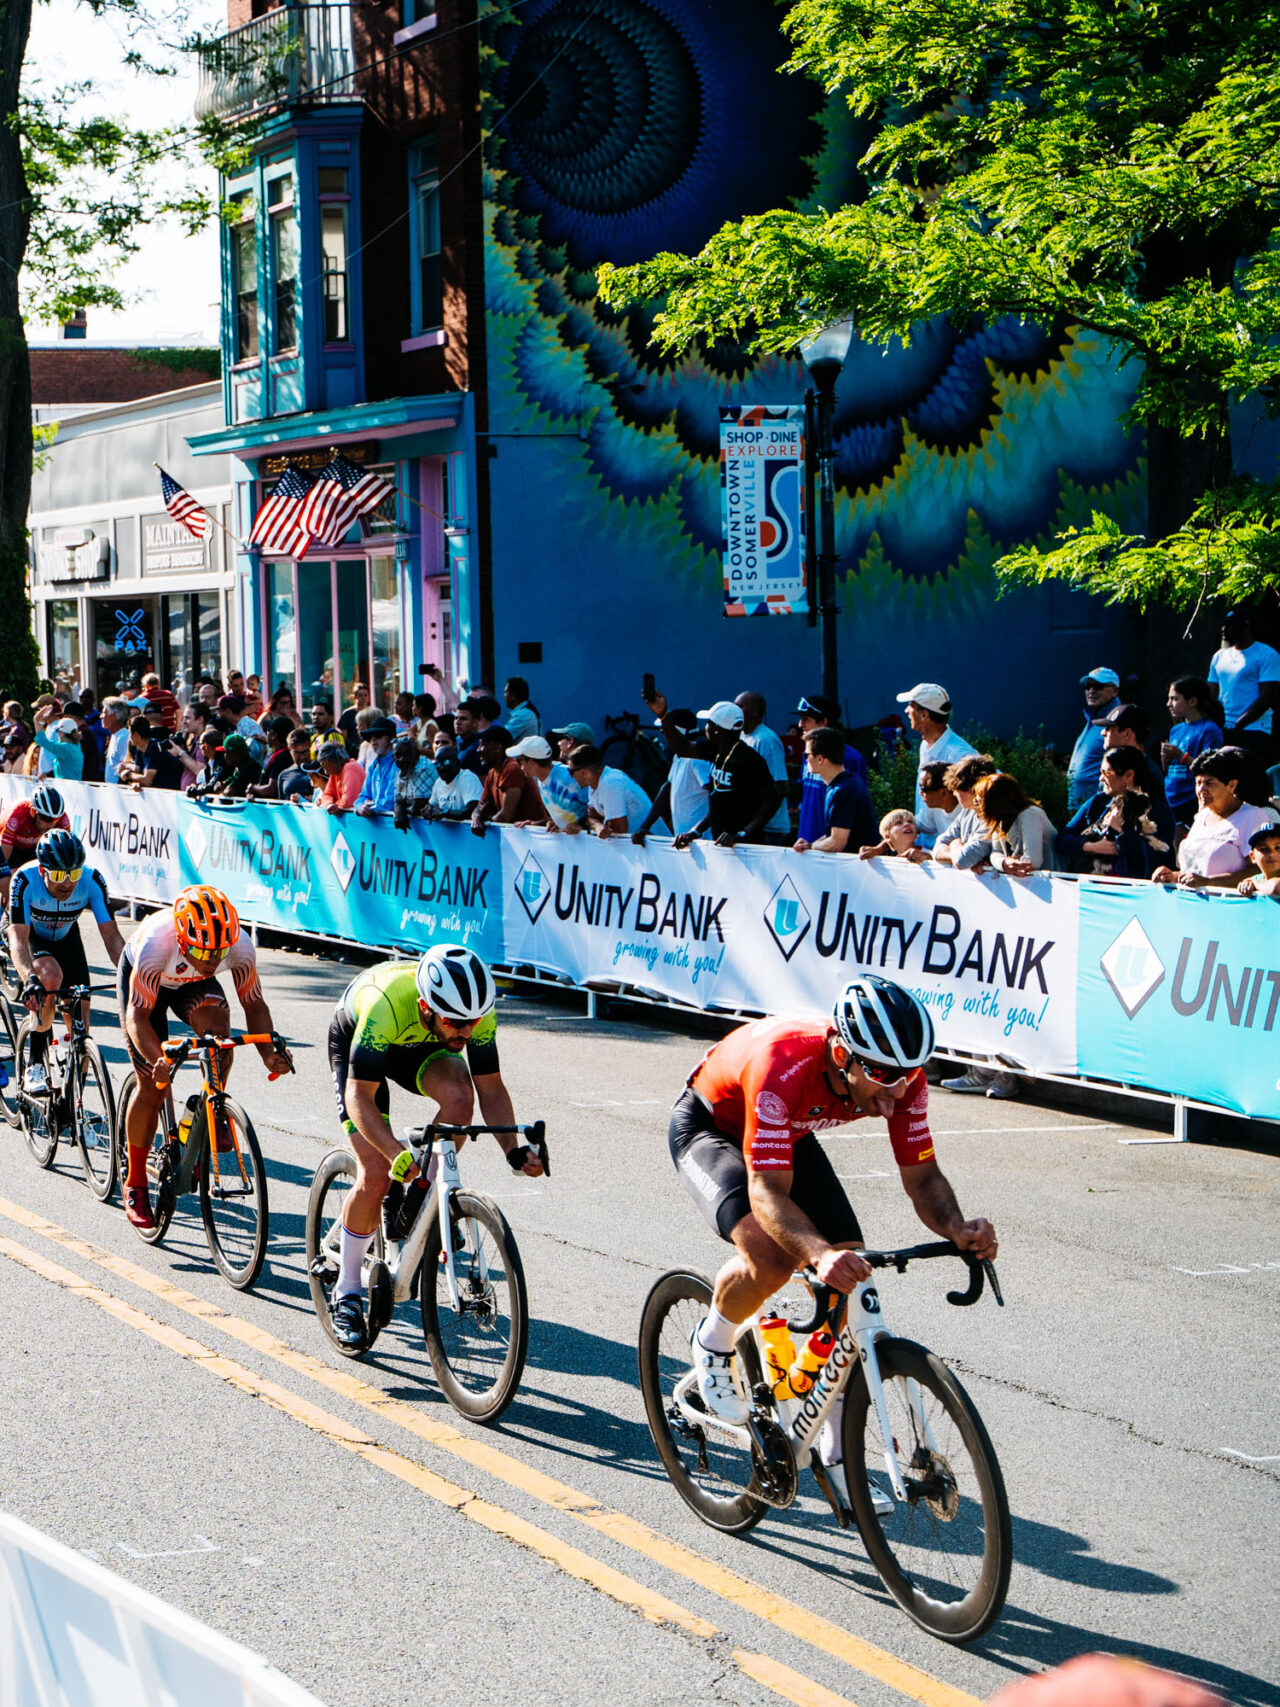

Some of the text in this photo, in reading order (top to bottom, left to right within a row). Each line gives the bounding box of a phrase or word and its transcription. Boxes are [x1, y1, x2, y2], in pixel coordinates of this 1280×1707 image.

[727, 431, 797, 443] SHOP DINE
[728, 445, 797, 456] EXPLORE
[729, 459, 743, 581] DOWNTOWN
[744, 459, 758, 581] SOMERVILLE
[759, 582, 802, 590] JERSEY
[114, 640, 148, 652] PAX
[399, 907, 437, 936] growing
[441, 909, 461, 933] with
[612, 938, 726, 985] growing with you!
[963, 986, 1001, 1019] with
[1006, 996, 1050, 1037] you!
